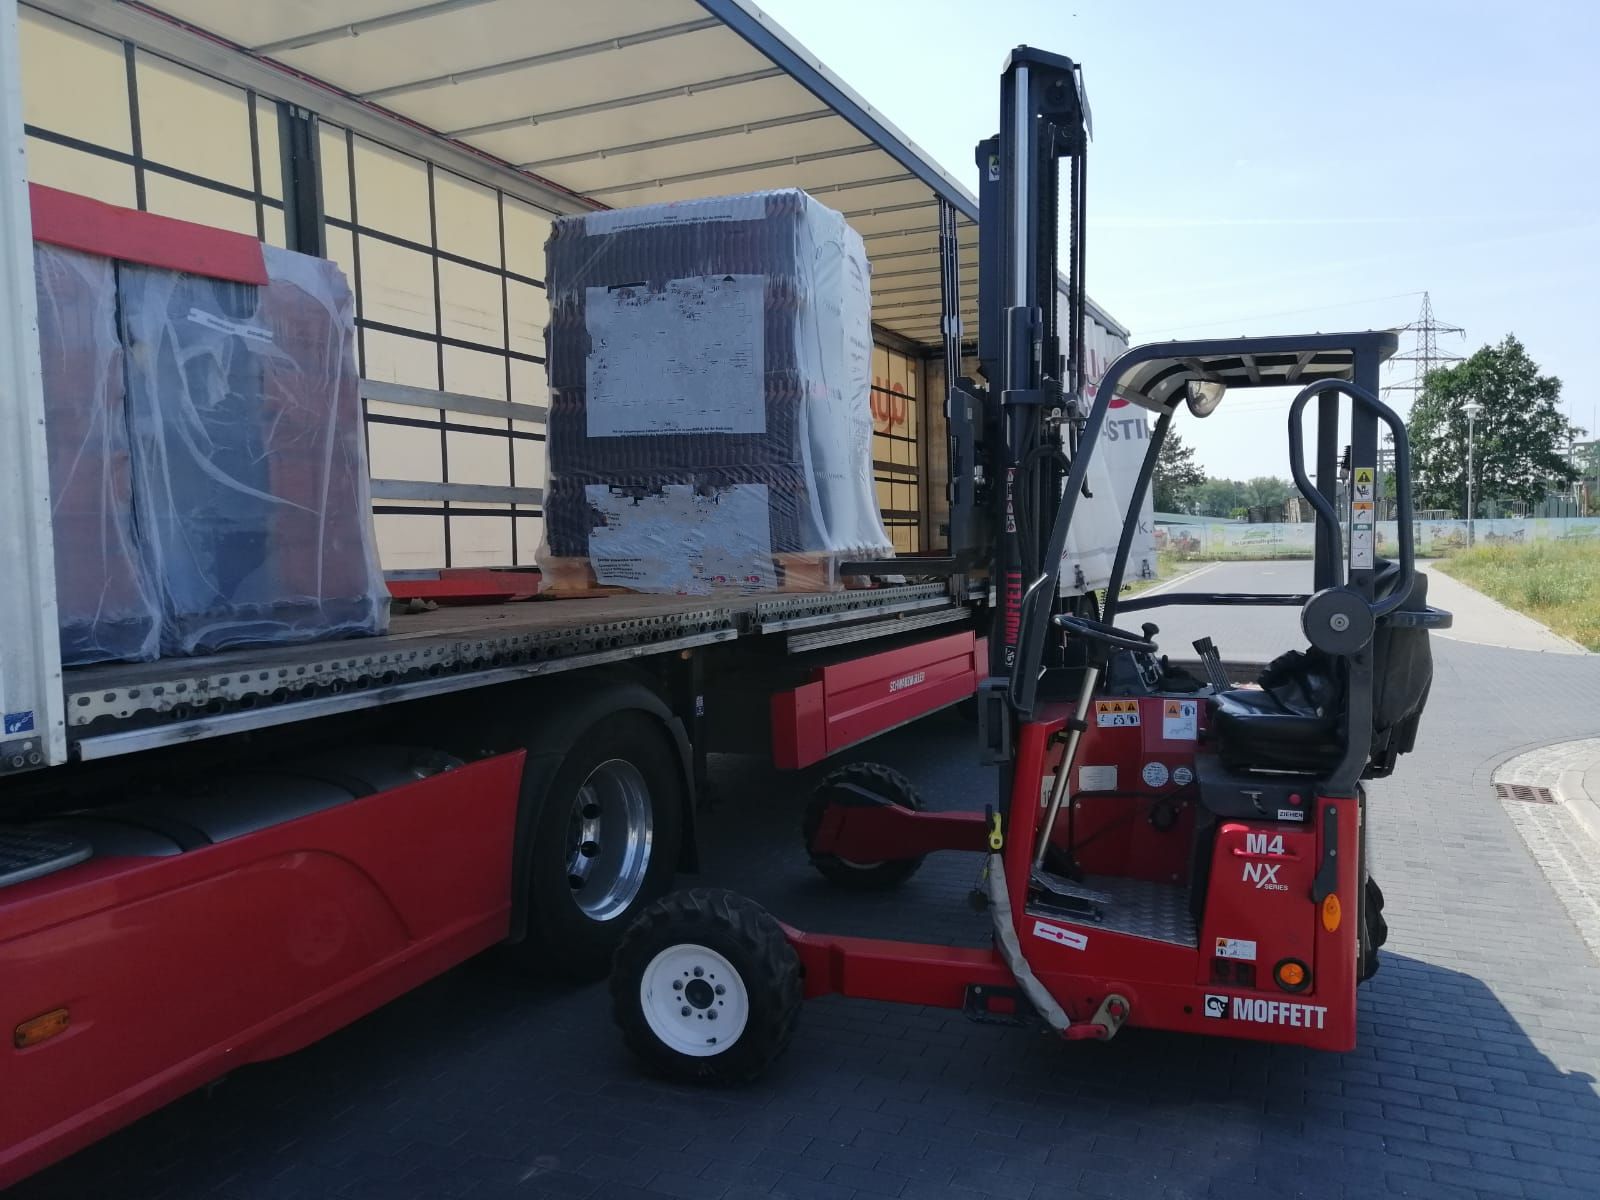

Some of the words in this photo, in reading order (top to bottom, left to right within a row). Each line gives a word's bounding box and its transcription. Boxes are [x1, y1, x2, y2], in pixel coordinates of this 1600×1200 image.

[1006, 572, 1023, 644] MOFFETT
[1246, 833, 1285, 856] M4
[1242, 862, 1281, 889] NX
[1264, 883, 1289, 891] SERIES
[1233, 997, 1328, 1030] MOFFETT
